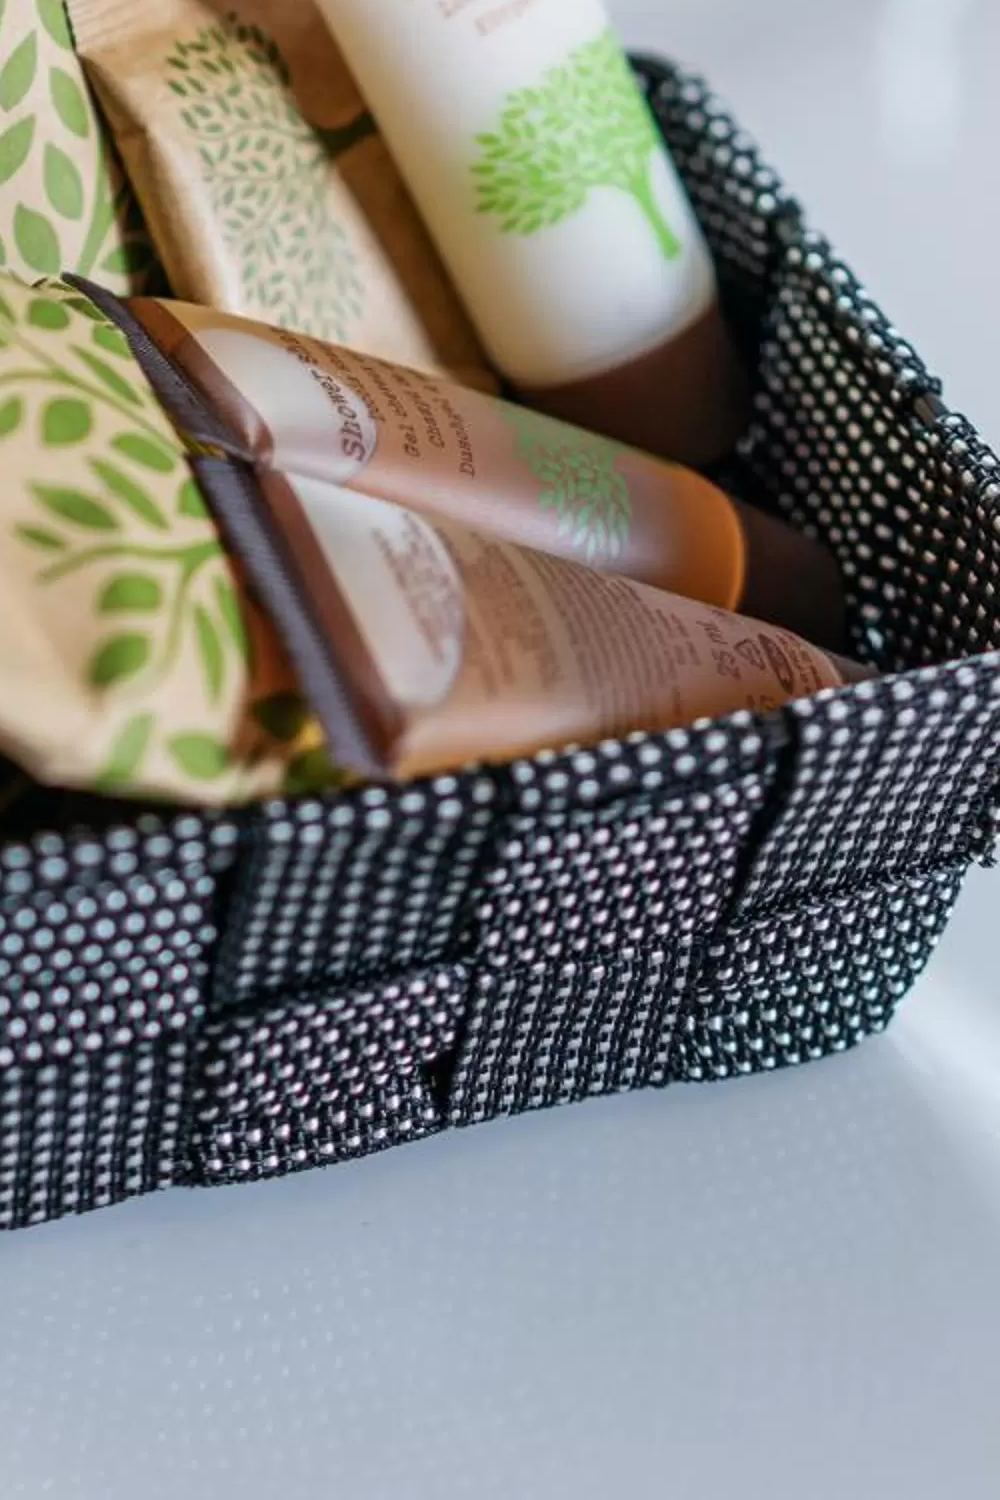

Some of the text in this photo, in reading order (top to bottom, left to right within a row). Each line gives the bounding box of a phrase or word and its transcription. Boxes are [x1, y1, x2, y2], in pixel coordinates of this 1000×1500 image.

[310, 369, 366, 462] Shower
[400, 423, 421, 458] Gel
[695, 620, 742, 681] 25 ml
